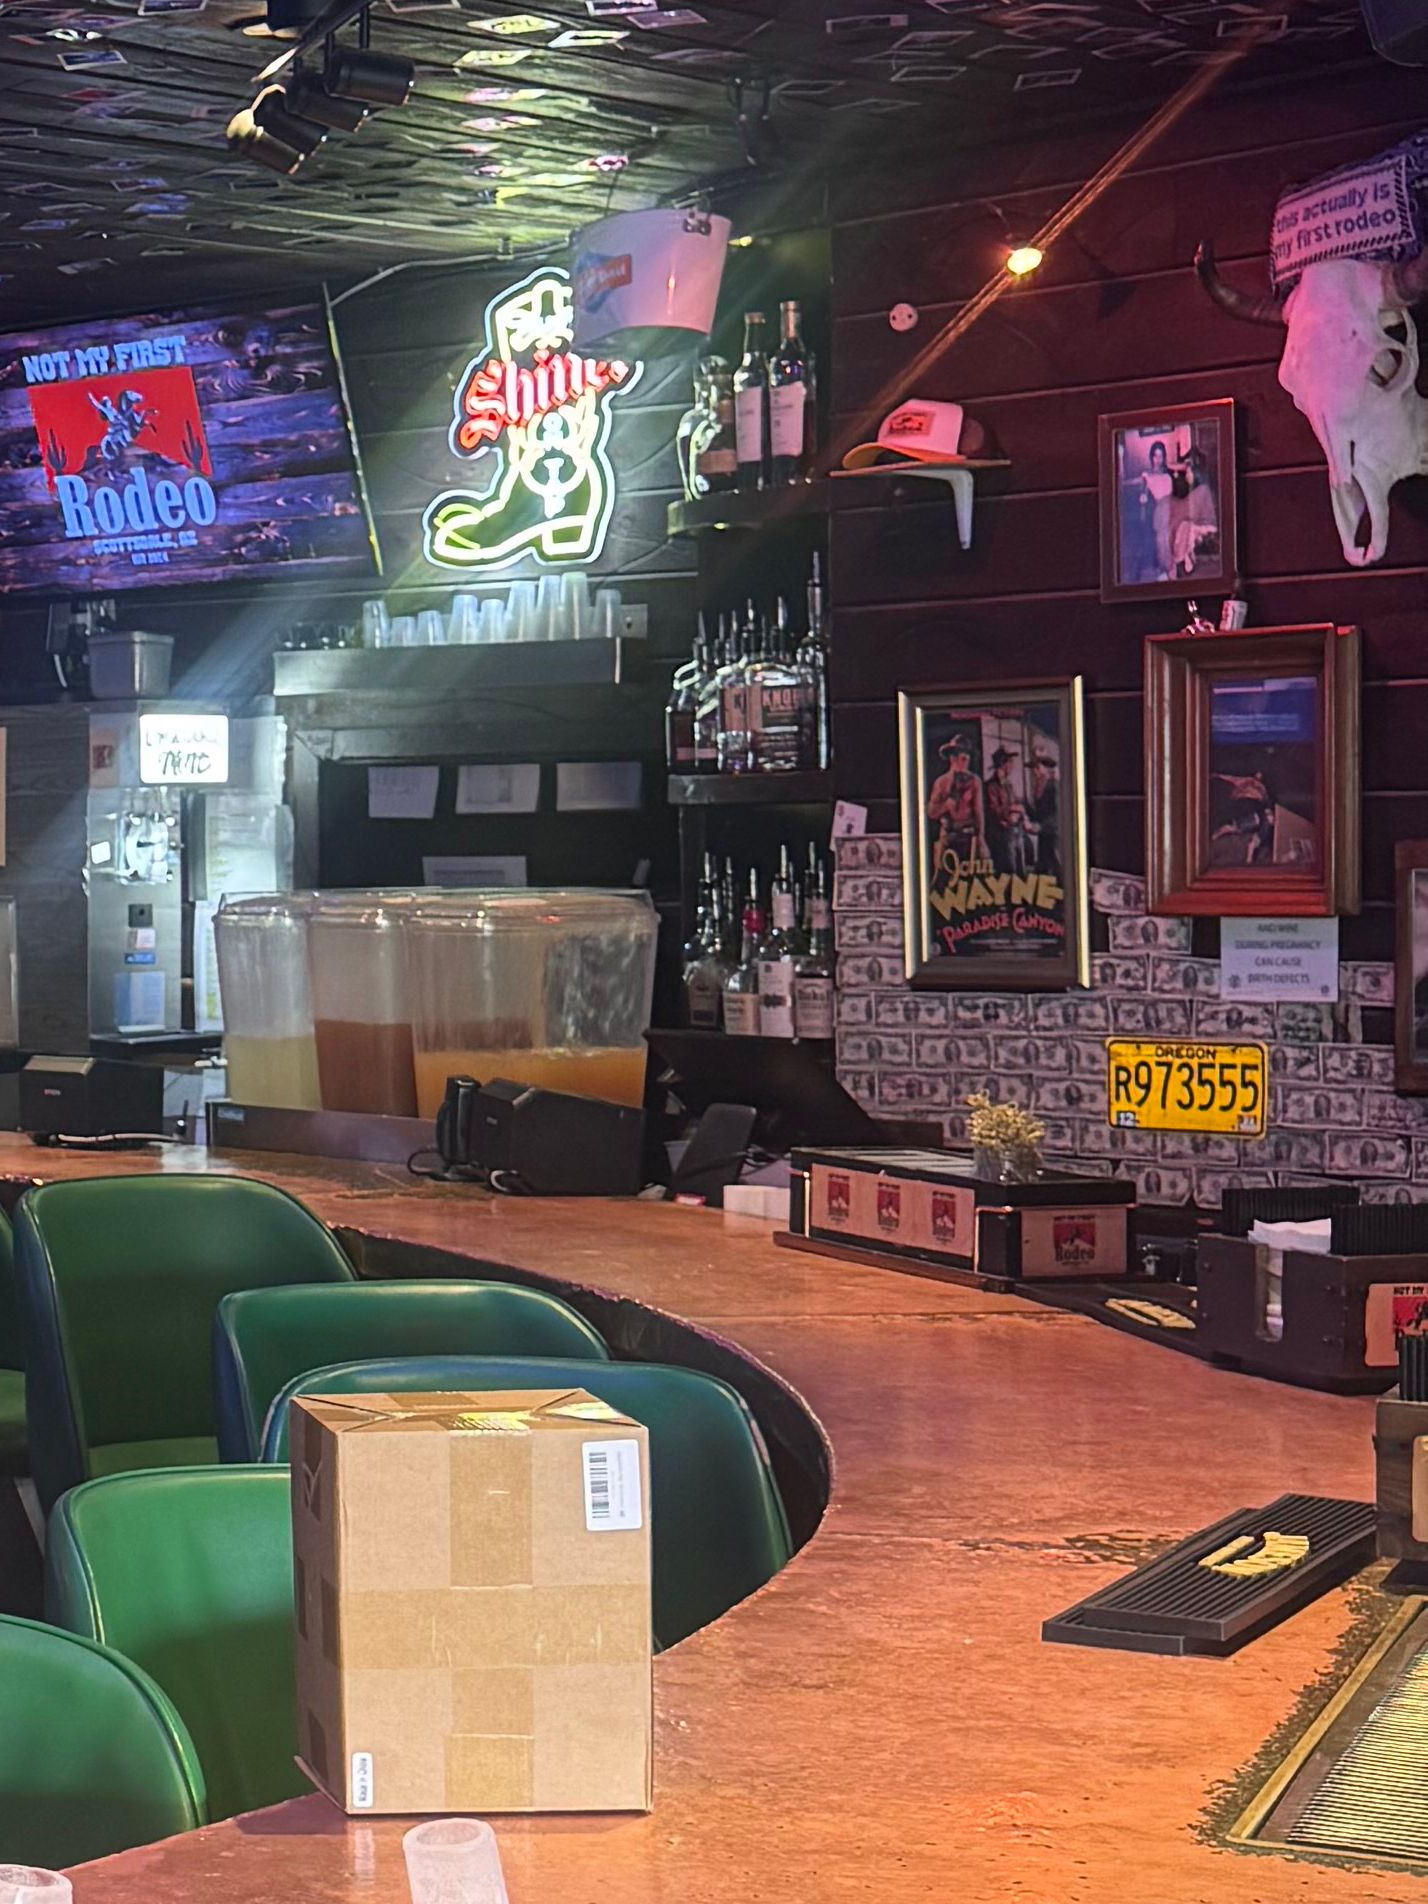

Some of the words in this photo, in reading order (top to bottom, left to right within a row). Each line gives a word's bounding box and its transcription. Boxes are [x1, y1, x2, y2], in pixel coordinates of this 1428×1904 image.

[1275, 238, 1292, 260] my
[1297, 223, 1331, 249] first
[1335, 208, 1396, 236] rodeo
[1277, 212, 1299, 234] this
[1303, 186, 1367, 221] actually
[1374, 183, 1390, 202] is
[23, 350, 70, 383] NOT
[75, 345, 109, 378] MY
[114, 335, 186, 372] FIRST
[54, 466, 216, 539] Rodeo
[943, 836, 994, 888] John
[930, 873, 1064, 921] WAYNE
[1154, 1045, 1217, 1060] OREGON
[1114, 1060, 1260, 1112] R973555
